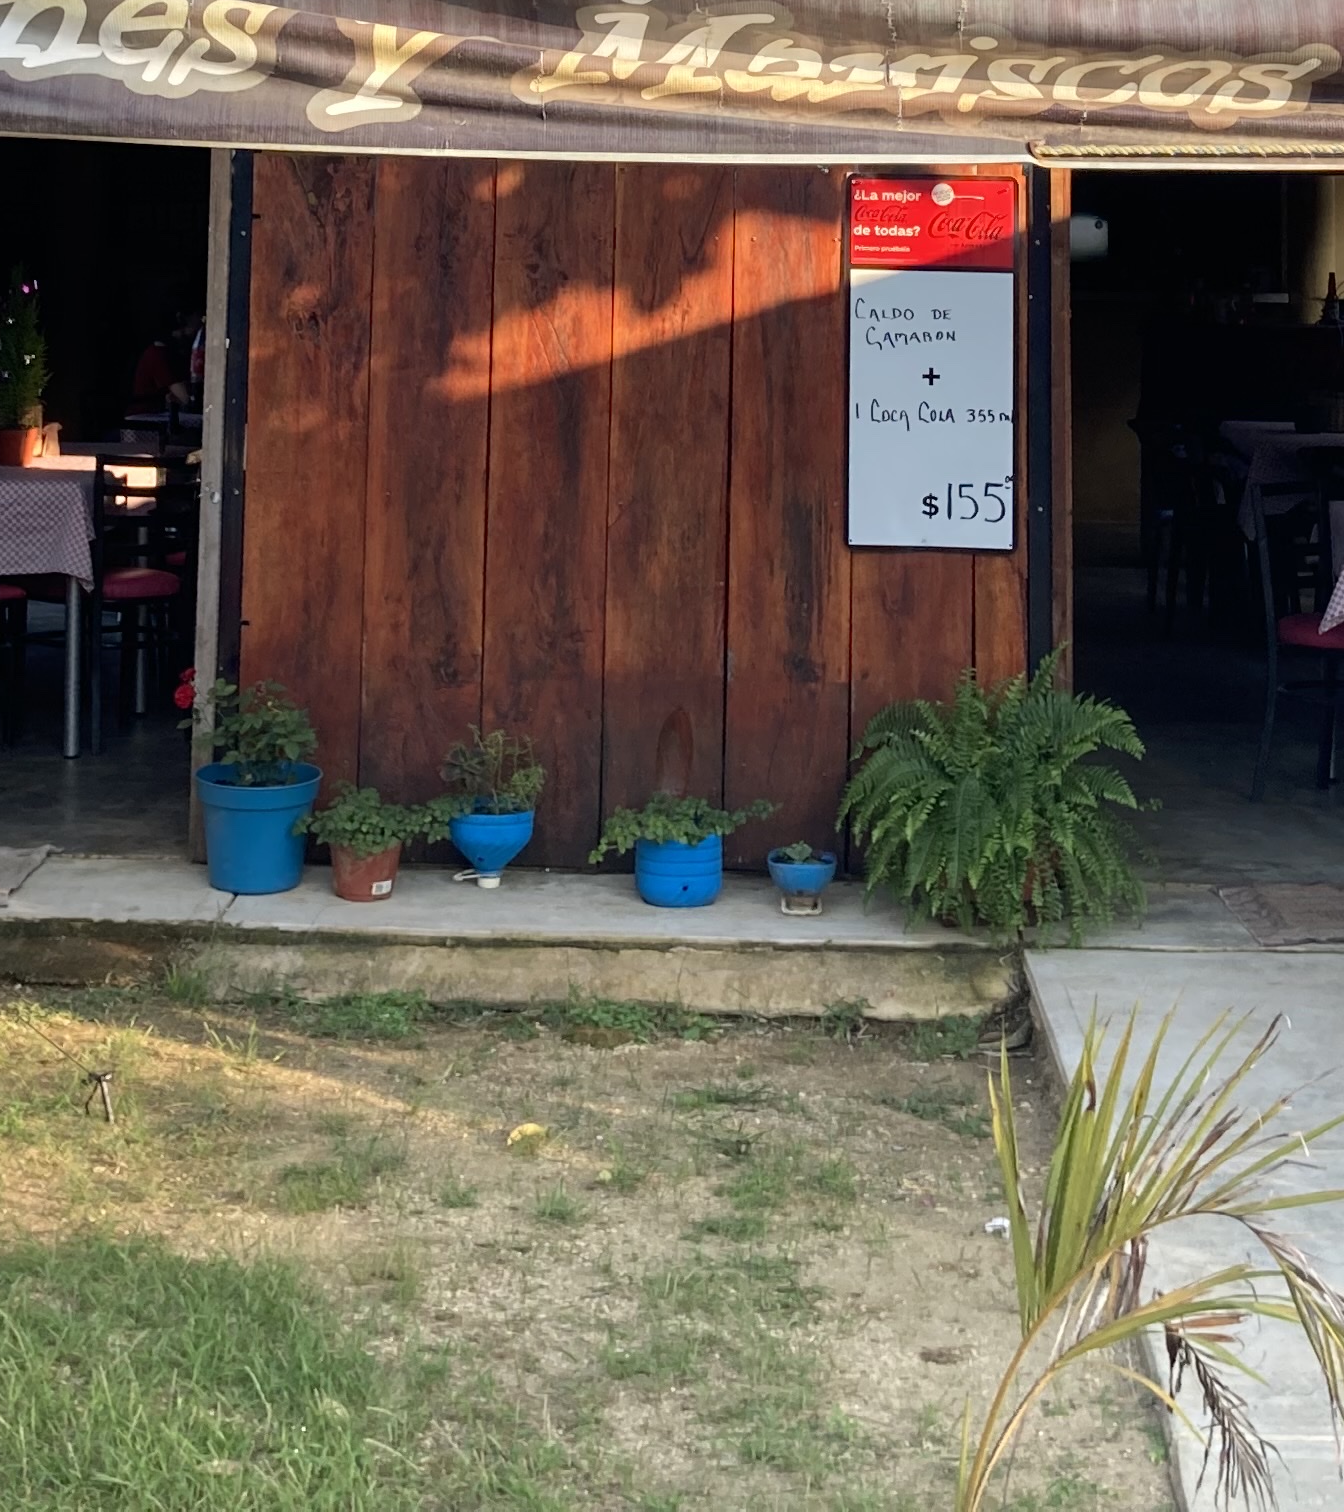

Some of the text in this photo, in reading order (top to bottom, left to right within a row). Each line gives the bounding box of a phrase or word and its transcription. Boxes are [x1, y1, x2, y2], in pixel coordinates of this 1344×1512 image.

[524, 8, 1330, 118] Mariscos
[853, 189, 879, 201] ¿La
[881, 189, 922, 204] mejor
[853, 224, 921, 237] de todas?
[855, 297, 952, 322] CALDO DE
[870, 398, 911, 432] COCA
[918, 401, 956, 424] COLA
